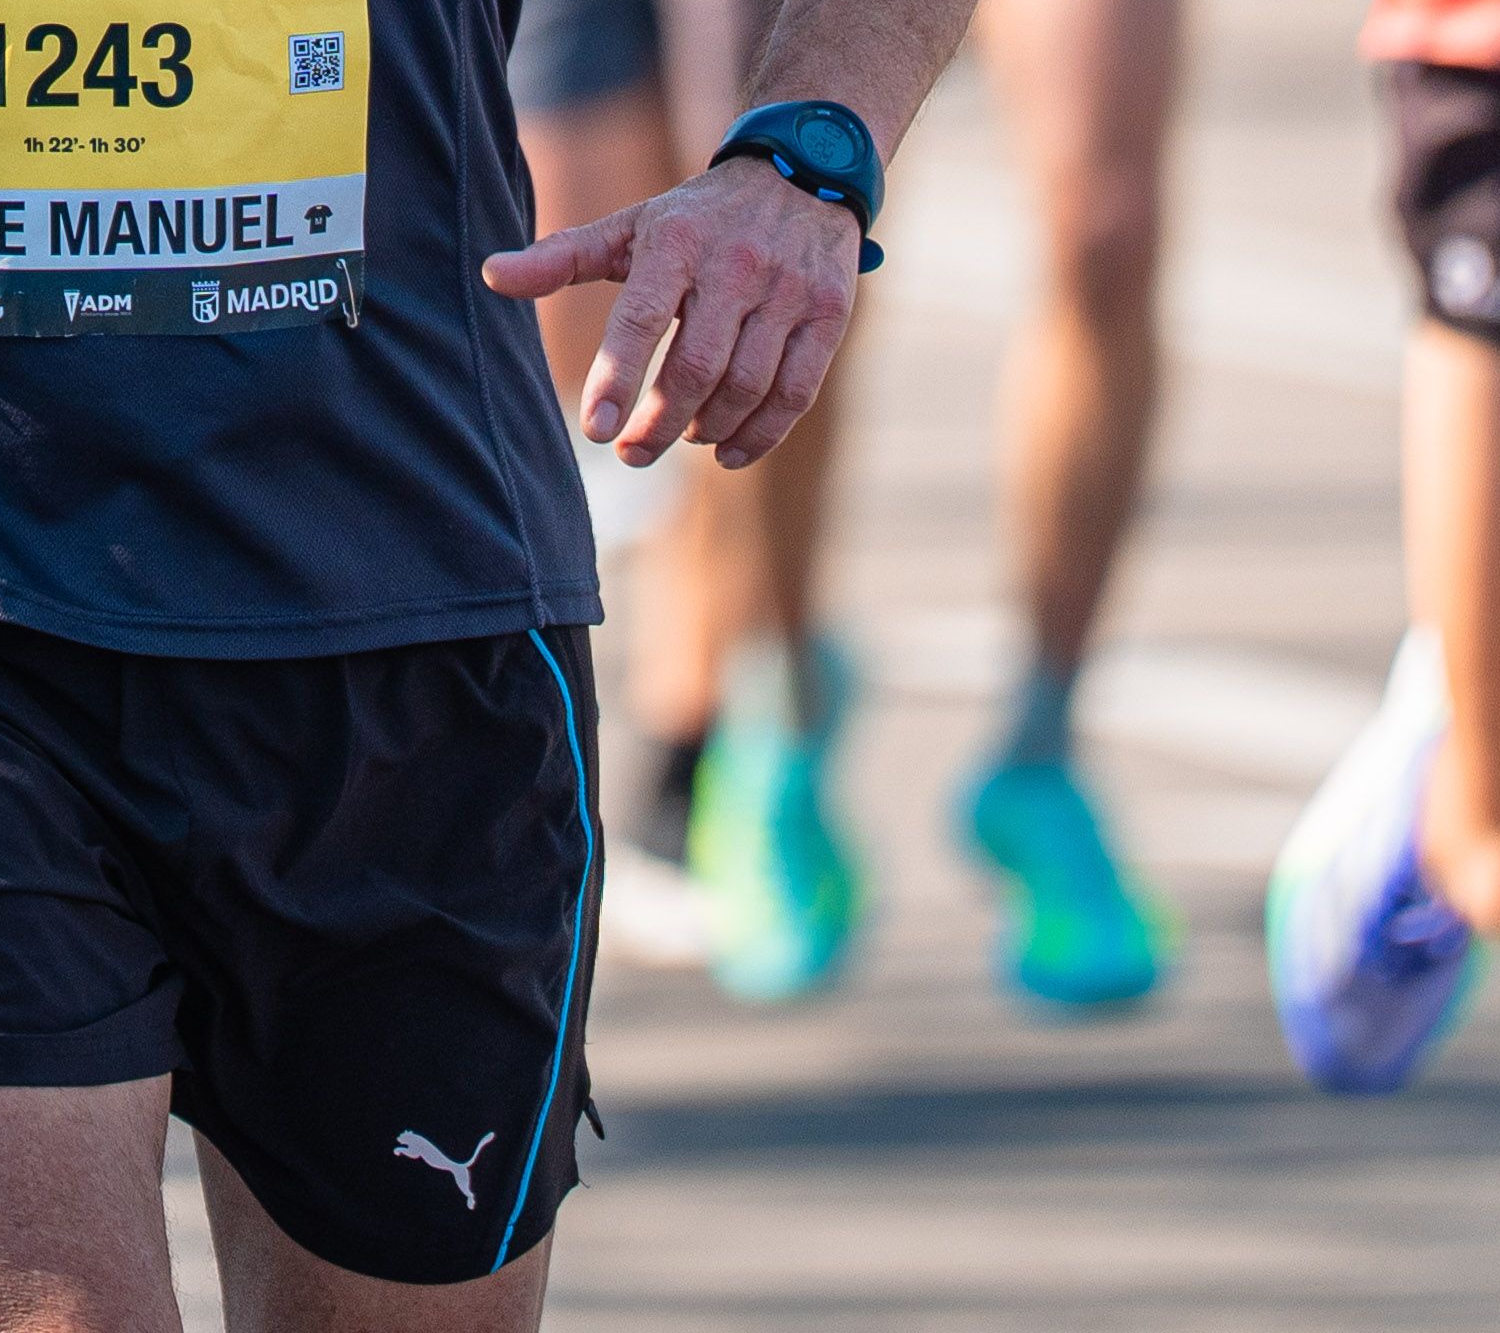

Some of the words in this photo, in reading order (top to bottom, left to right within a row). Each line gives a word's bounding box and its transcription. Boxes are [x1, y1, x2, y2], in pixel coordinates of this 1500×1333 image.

[24, 137, 44, 153] 1h
[89, 137, 109, 153] 1h
[49, 193, 294, 257] MANUEL
[80, 294, 132, 312] ADM
[227, 278, 338, 314] MADRID
